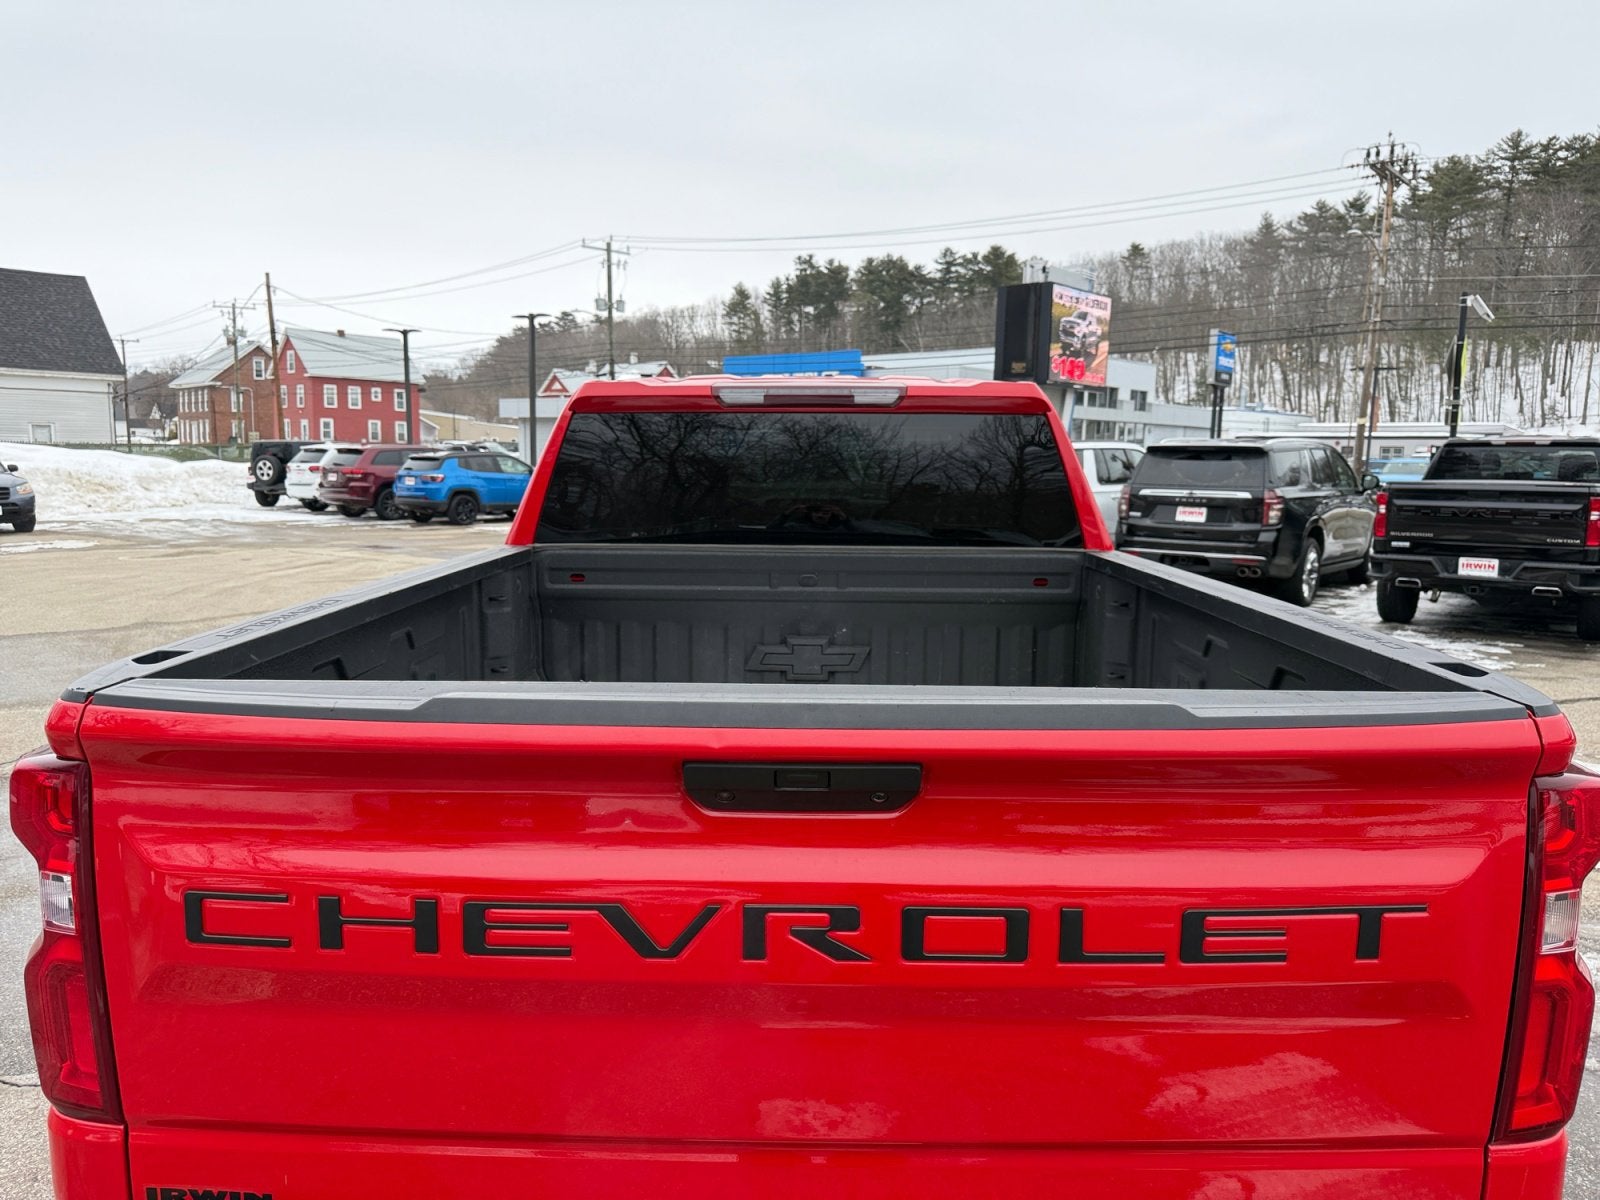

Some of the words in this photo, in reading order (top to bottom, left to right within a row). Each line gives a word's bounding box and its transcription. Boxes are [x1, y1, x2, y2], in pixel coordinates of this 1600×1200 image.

[1461, 562, 1496, 570] IRWIN
[184, 889, 1428, 964] CHEVROLET
[145, 1187, 273, 1200] IRWIN
